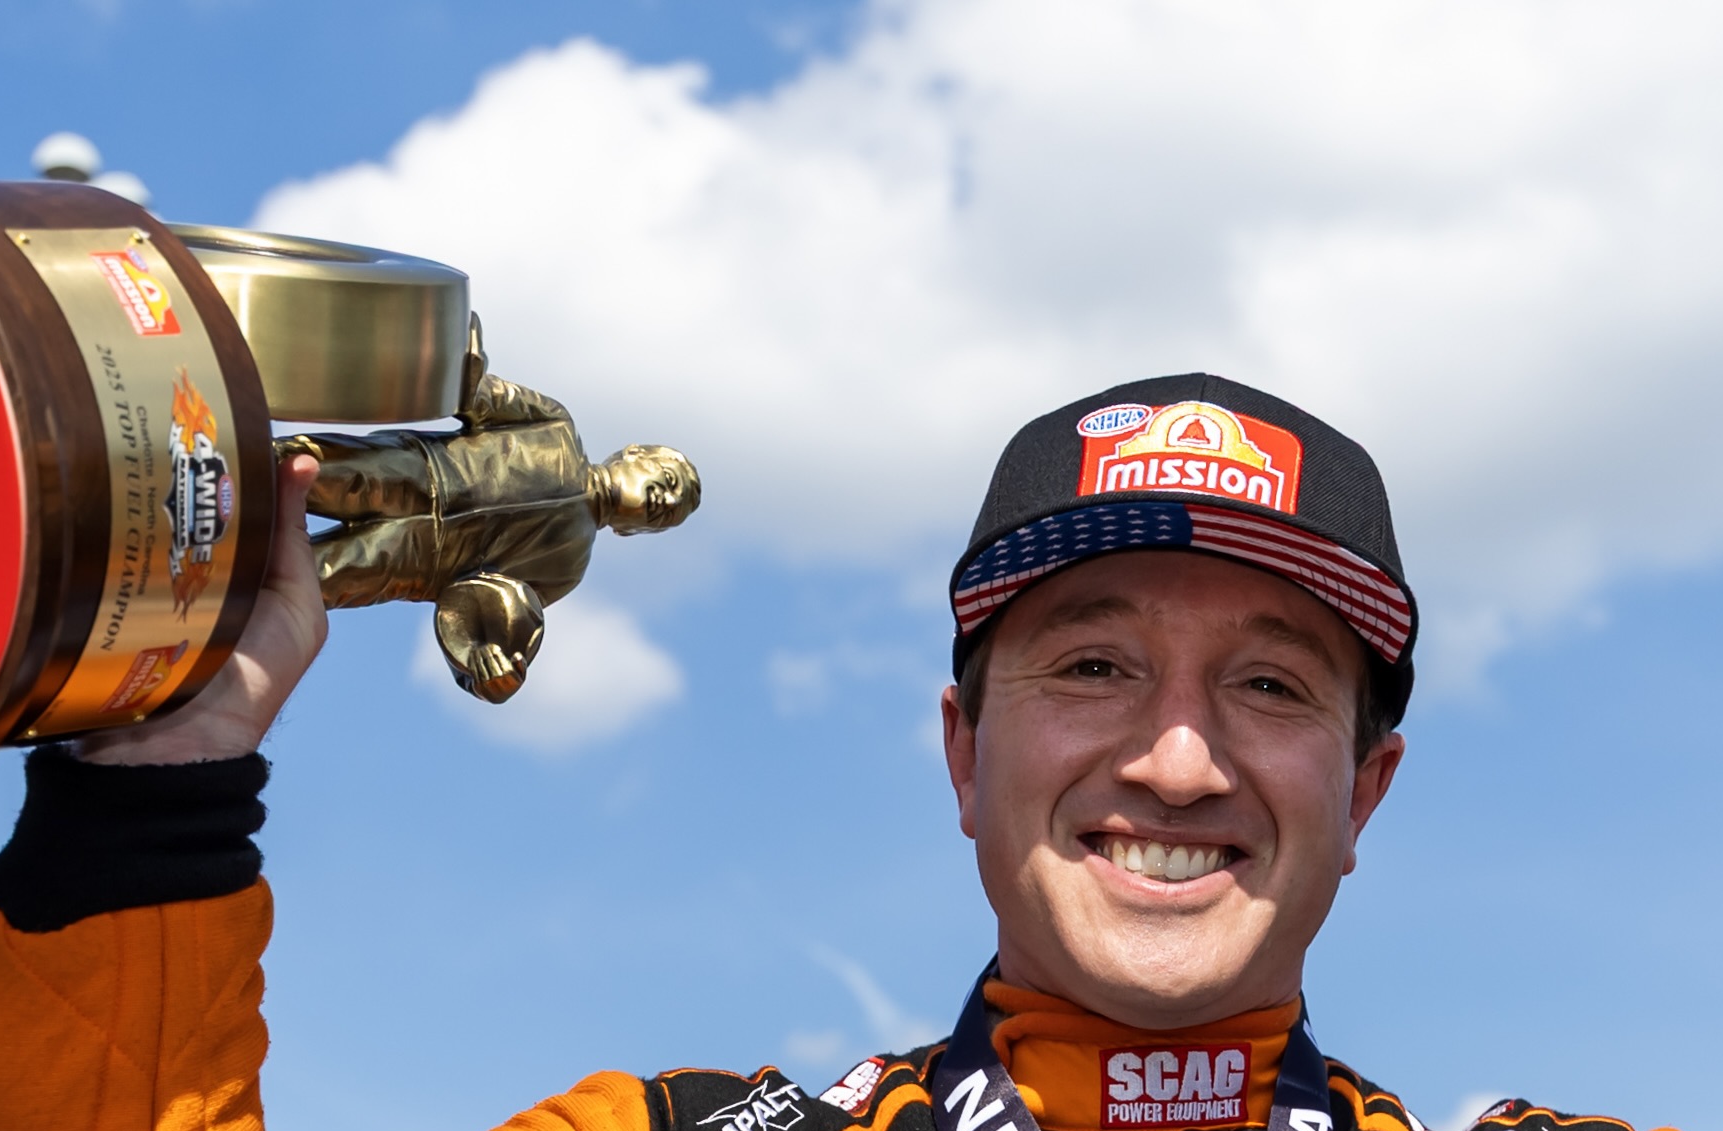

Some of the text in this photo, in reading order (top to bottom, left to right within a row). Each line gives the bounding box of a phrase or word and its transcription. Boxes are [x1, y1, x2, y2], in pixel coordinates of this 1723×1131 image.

[95, 343, 125, 392] 2025
[115, 401, 137, 449] TOP
[1086, 408, 1143, 433] NHRA
[124, 455, 142, 521] FUEL
[177, 458, 187, 547] NATIONALS
[190, 432, 217, 563] 4-WIDE
[220, 479, 232, 516] NHRA
[1105, 458, 1272, 506] MISSION
[146, 487, 157, 530] North
[100, 527, 141, 651] CHAMPION
[137, 535, 156, 596] Carolina
[1106, 1048, 1246, 1101] SCAG
[1107, 1099, 1242, 1123] POWER EQUIPMENT
